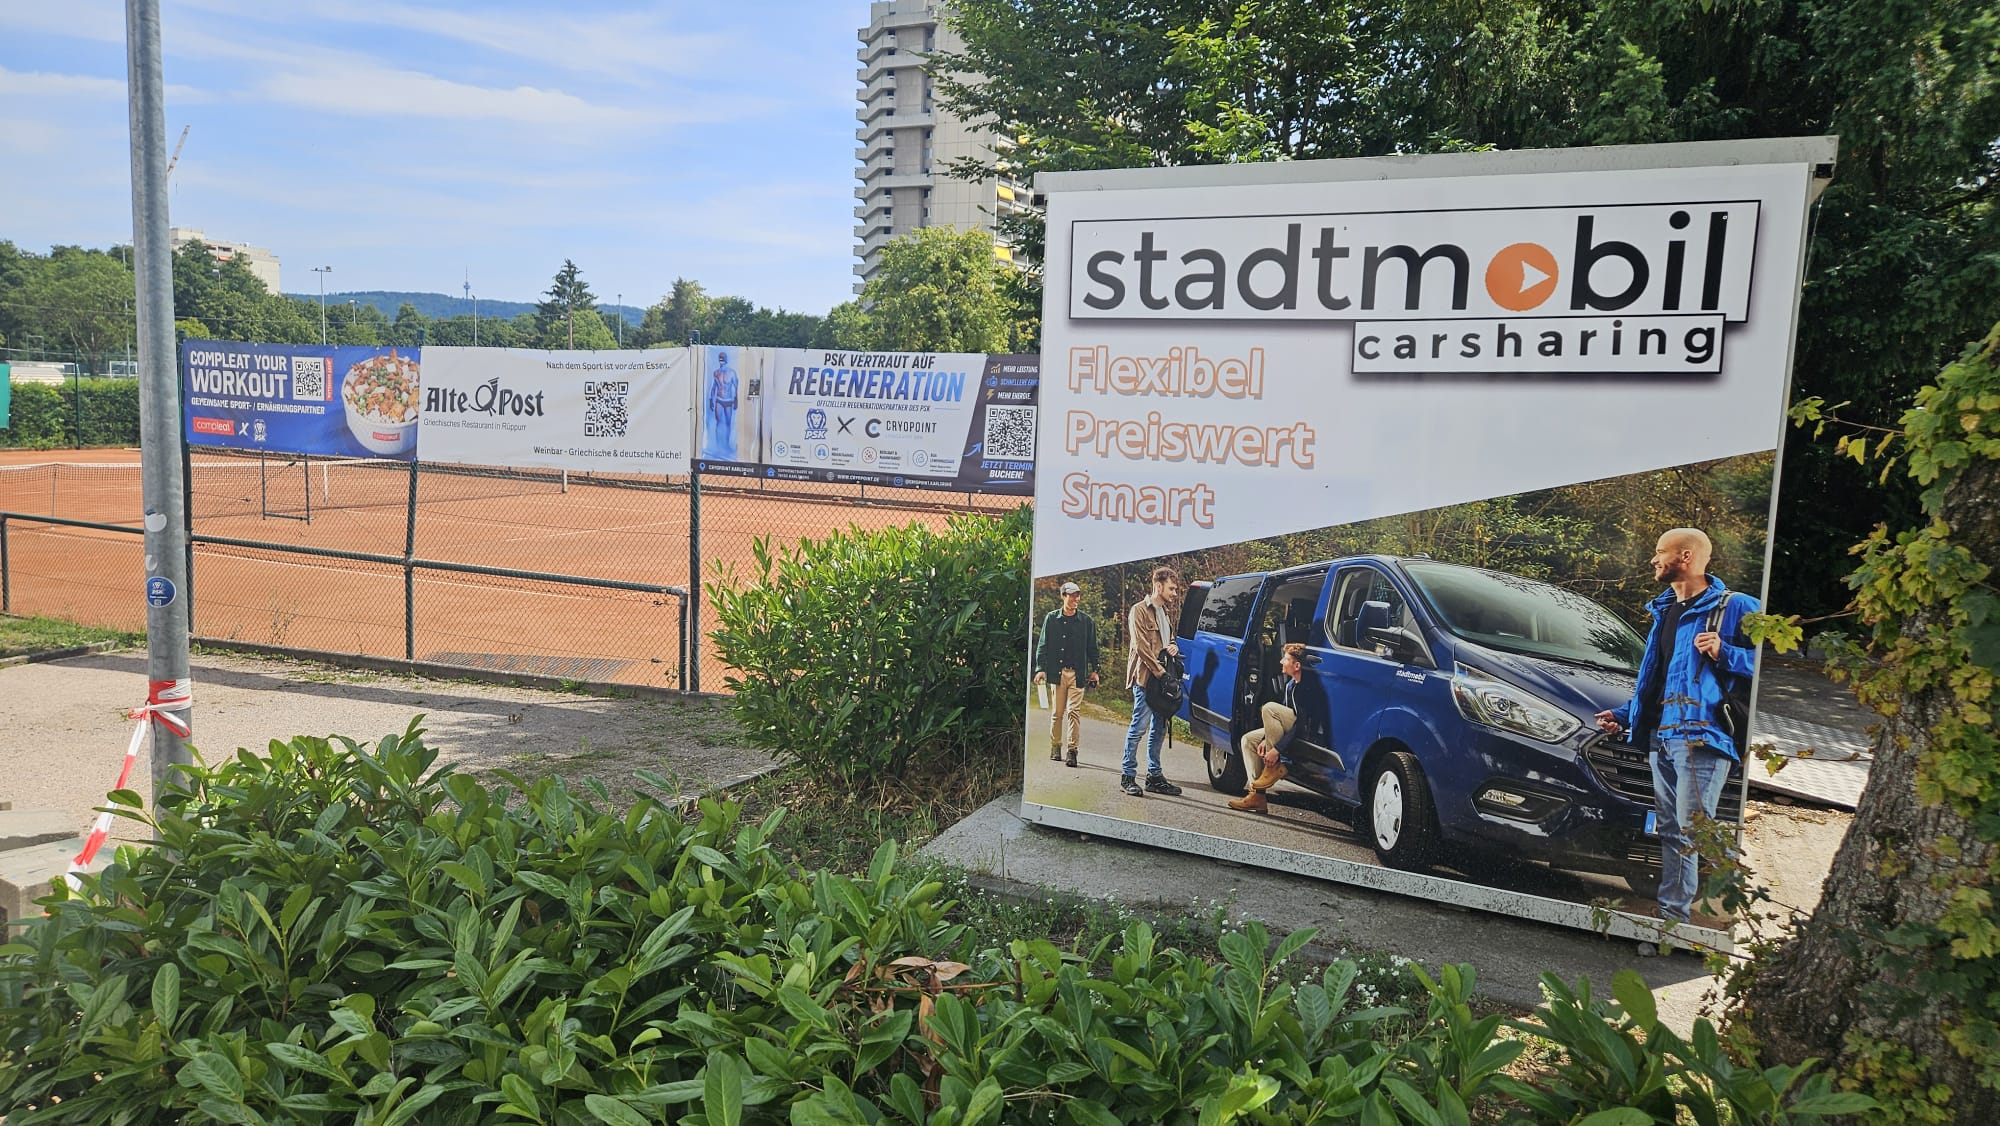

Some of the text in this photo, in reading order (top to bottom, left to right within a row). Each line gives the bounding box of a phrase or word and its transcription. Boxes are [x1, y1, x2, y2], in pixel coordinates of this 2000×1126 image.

[1083, 211, 1729, 312] stadtmobil
[1358, 319, 1716, 364] carsharing
[190, 350, 287, 371] COMPLEAT YOUR
[546, 361, 564, 369] Nach
[565, 362, 581, 370] dem
[582, 361, 603, 372] Sport
[604, 362, 614, 370] ist
[628, 361, 644, 370] dem
[645, 361, 670, 370] Essen.
[824, 353, 936, 369] PSK VERTRAUT AUF
[1003, 365, 1017, 373] MEHR
[1068, 345, 1265, 400] Flexibel
[190, 367, 288, 399] WORKOUT
[788, 366, 966, 402] REGENERATION
[424, 387, 545, 417] Alte Post
[997, 391, 1012, 399] MEHR
[191, 397, 229, 408] GEMEINSAME
[230, 400, 252, 410] SPORT-
[257, 401, 325, 415] ERNÄHRUNGSPARTNER
[816, 399, 847, 407] OFFIZIELLER
[847, 401, 908, 411] REGENERATIONSPARTNER
[196, 420, 231, 432] compleat
[423, 418, 526, 432] Griechisches Restaurant in Rüppurr
[804, 430, 827, 440] PSK
[886, 420, 937, 433] CRYOPOINT
[1065, 409, 1315, 470] Preiswert
[533, 446, 563, 456] Weinbar
[568, 447, 612, 457] Griechische
[613, 449, 618, 457] &
[619, 449, 654, 459] deutsche
[655, 450, 682, 460] Küche!
[980, 461, 1034, 471] JETZT TERMIN
[989, 469, 1024, 480] BUCHEN!
[1062, 472, 1215, 529] Smart
